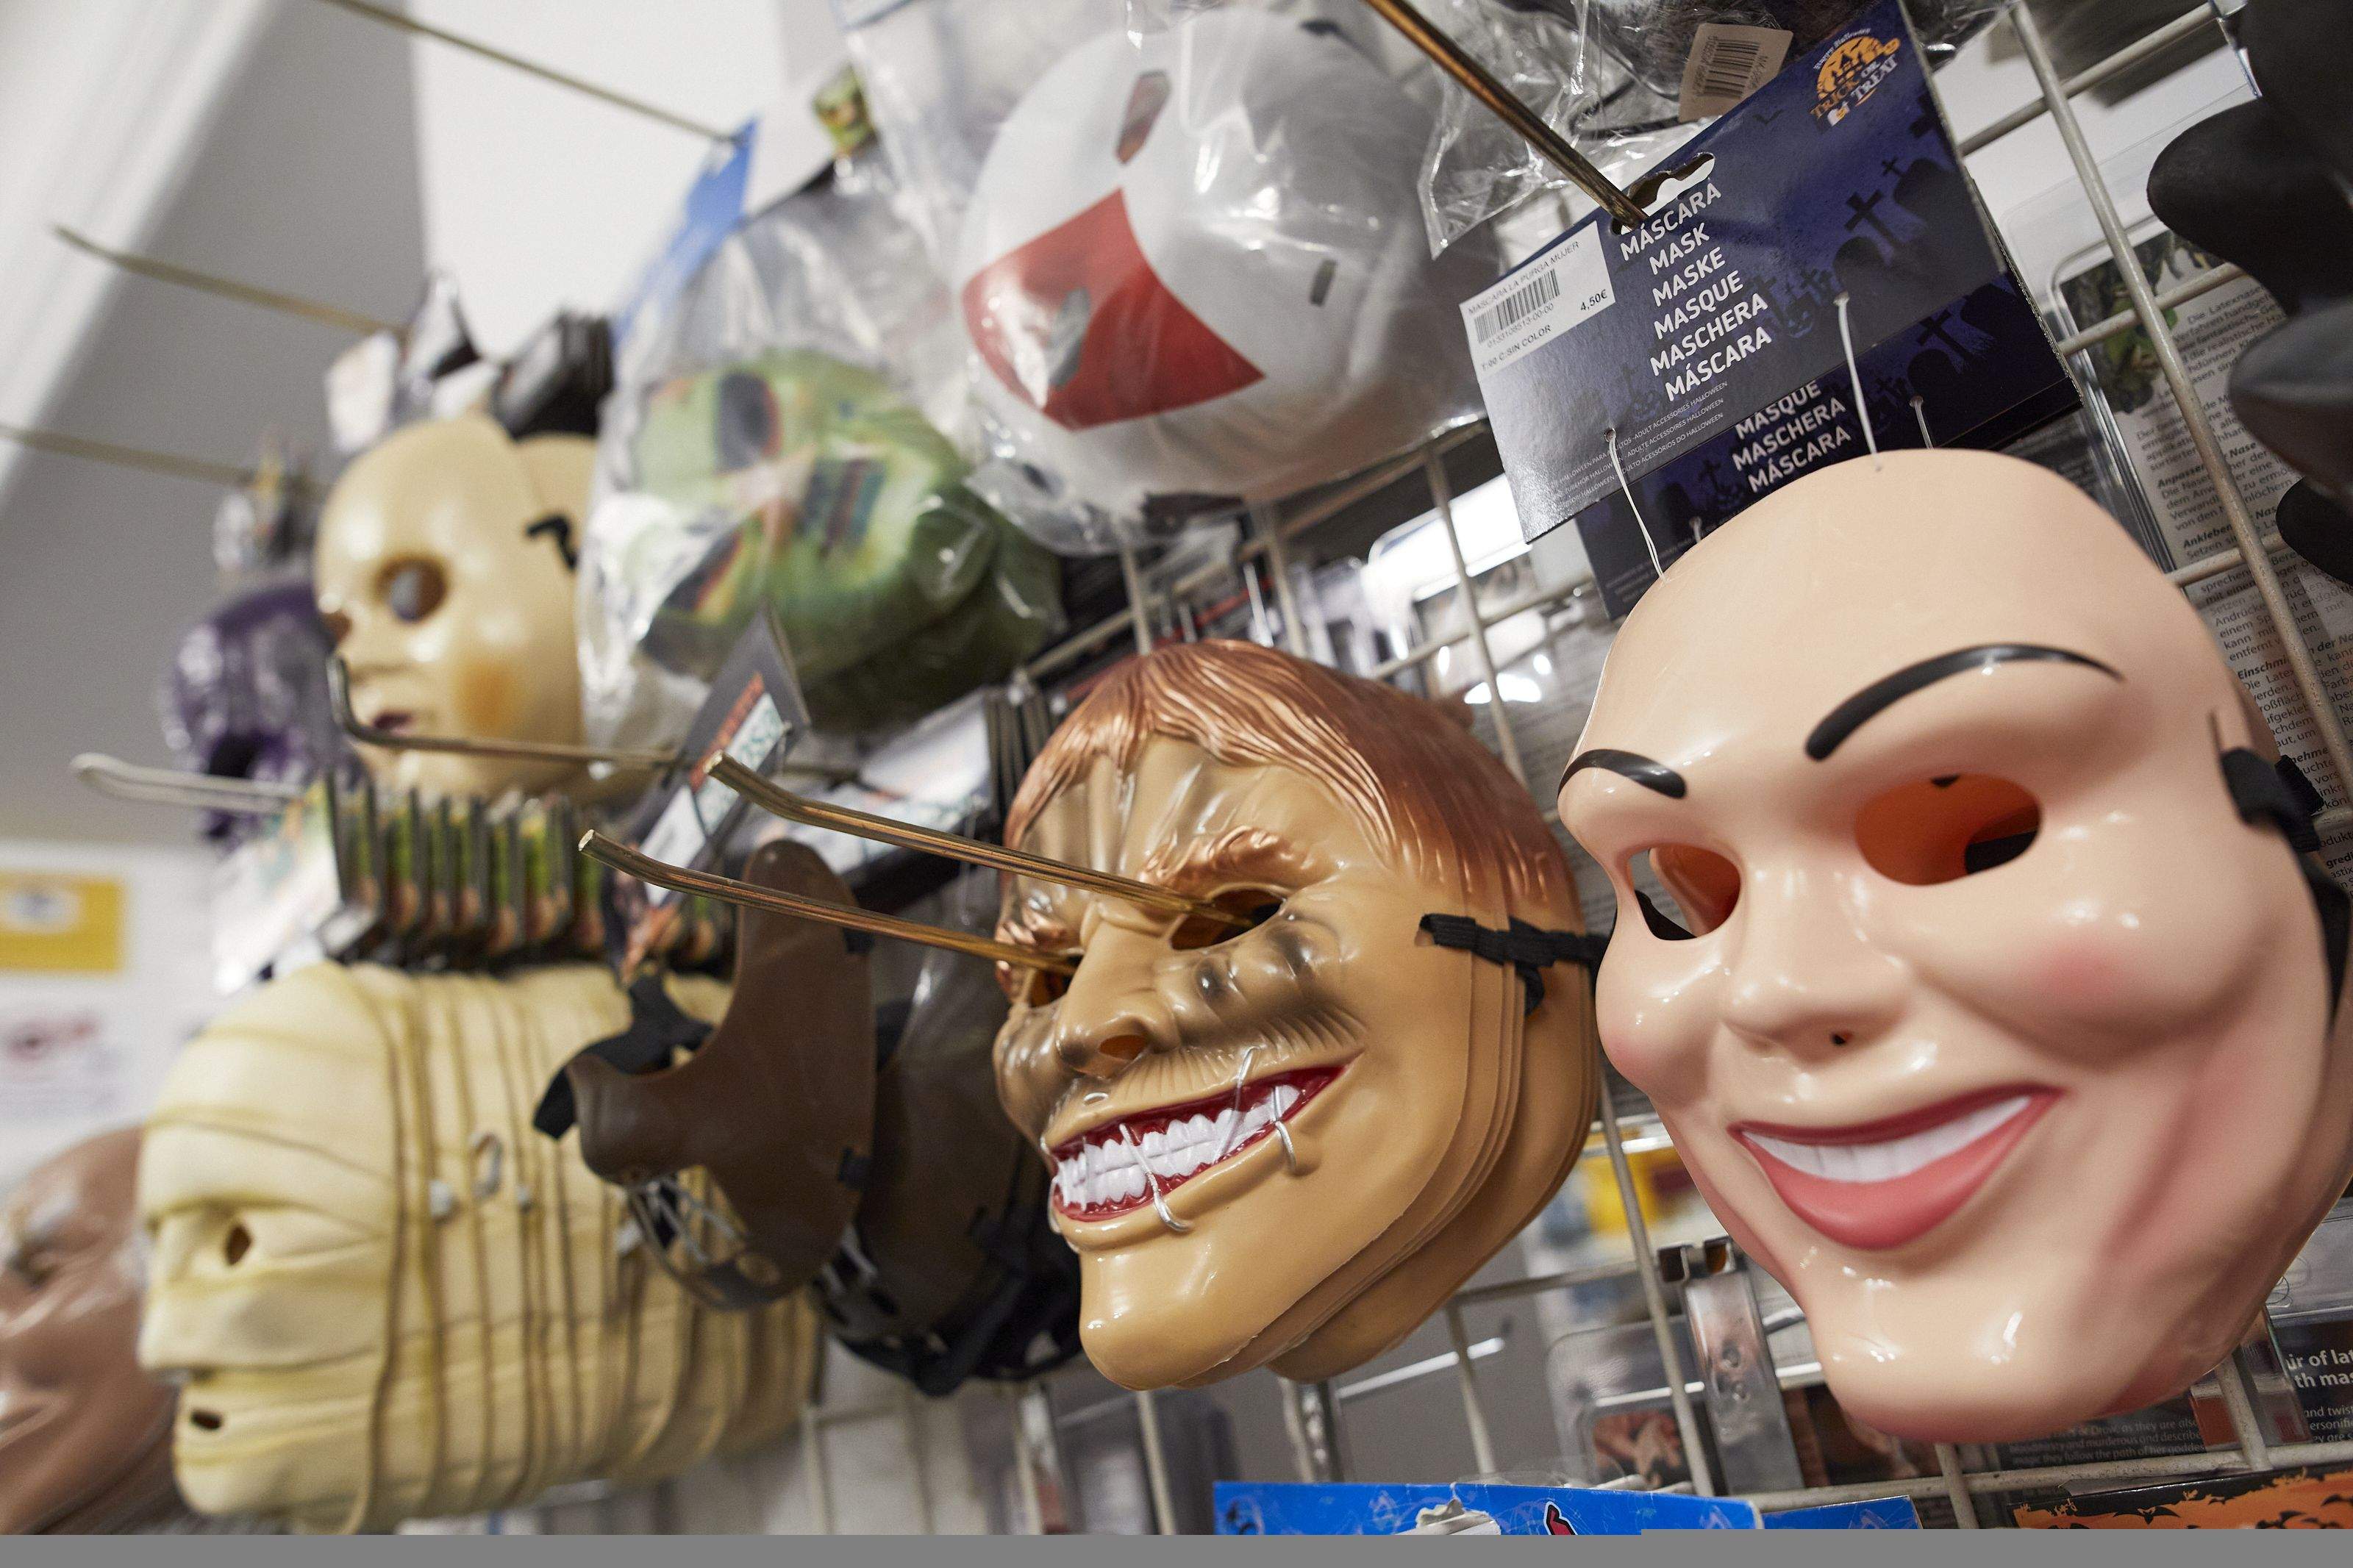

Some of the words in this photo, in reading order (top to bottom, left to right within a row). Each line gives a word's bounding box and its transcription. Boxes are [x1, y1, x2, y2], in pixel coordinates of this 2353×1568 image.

[1809, 80, 1860, 118] TRICK
[1860, 60, 1882, 78] OR
[1850, 54, 1898, 100] TREAT
[1620, 182, 1722, 262] MÁSCARA
[1549, 240, 1580, 265] MUJER
[1649, 222, 1710, 276] MASK
[1579, 289, 1609, 312] 4,50€
[1652, 246, 1726, 307] MASKE
[1654, 270, 1743, 340] MASQUE
[1522, 323, 1552, 348] COLOR
[1650, 293, 1768, 376] MASCHERA
[1665, 326, 1772, 401] MÁSCARA
[1627, 441, 1649, 458] ADULTE
[1649, 419, 1687, 445] ACCESSOIRES
[1687, 398, 1724, 423] HALLOWEEN
[1653, 403, 1690, 429] ACCESSORIES
[1690, 381, 1728, 407] HALLOWEEN
[1735, 380, 1822, 440] MASQUE
[1621, 459, 1641, 475] DULTO
[1676, 434, 1687, 444] DO
[1686, 412, 1724, 438] HALLOWEEN
[1732, 397, 1847, 472] MASCHERA
[1747, 426, 1852, 493] MÁSCARA
[2229, 441, 2257, 459] Nase
[2254, 505, 2278, 520] Nas
[2219, 619, 2254, 639] einem
[2223, 634, 2252, 651] kann
[2229, 639, 2273, 662] entfernt
[2316, 639, 2337, 653] der
[2308, 1350, 2328, 1367] of
